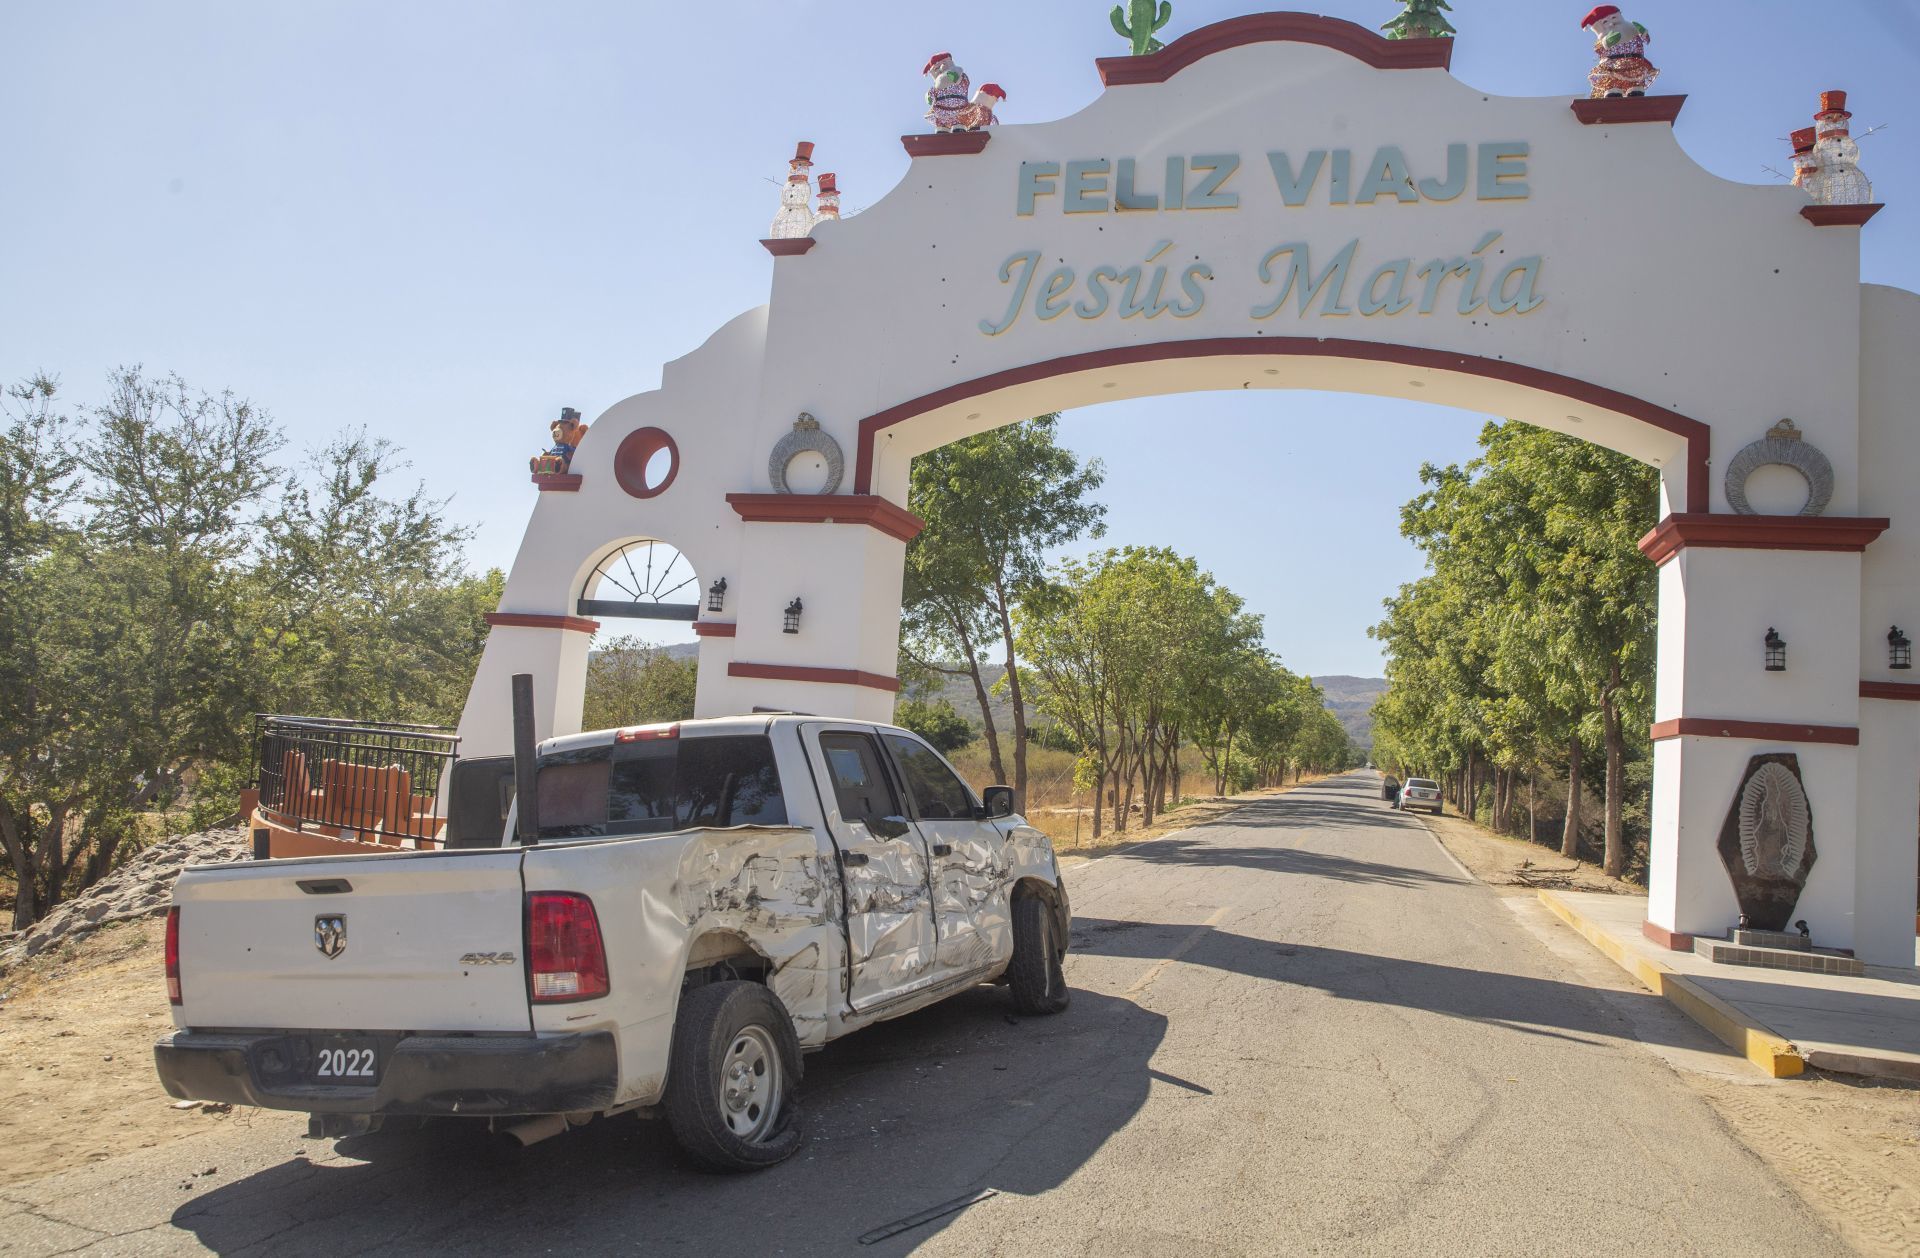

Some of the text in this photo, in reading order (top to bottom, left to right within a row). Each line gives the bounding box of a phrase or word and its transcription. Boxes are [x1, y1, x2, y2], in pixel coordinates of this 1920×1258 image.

[1017, 142, 1530, 216] FELIZ VIAJE
[978, 231, 1545, 336] Jesús María
[317, 1048, 375, 1077] 2022
